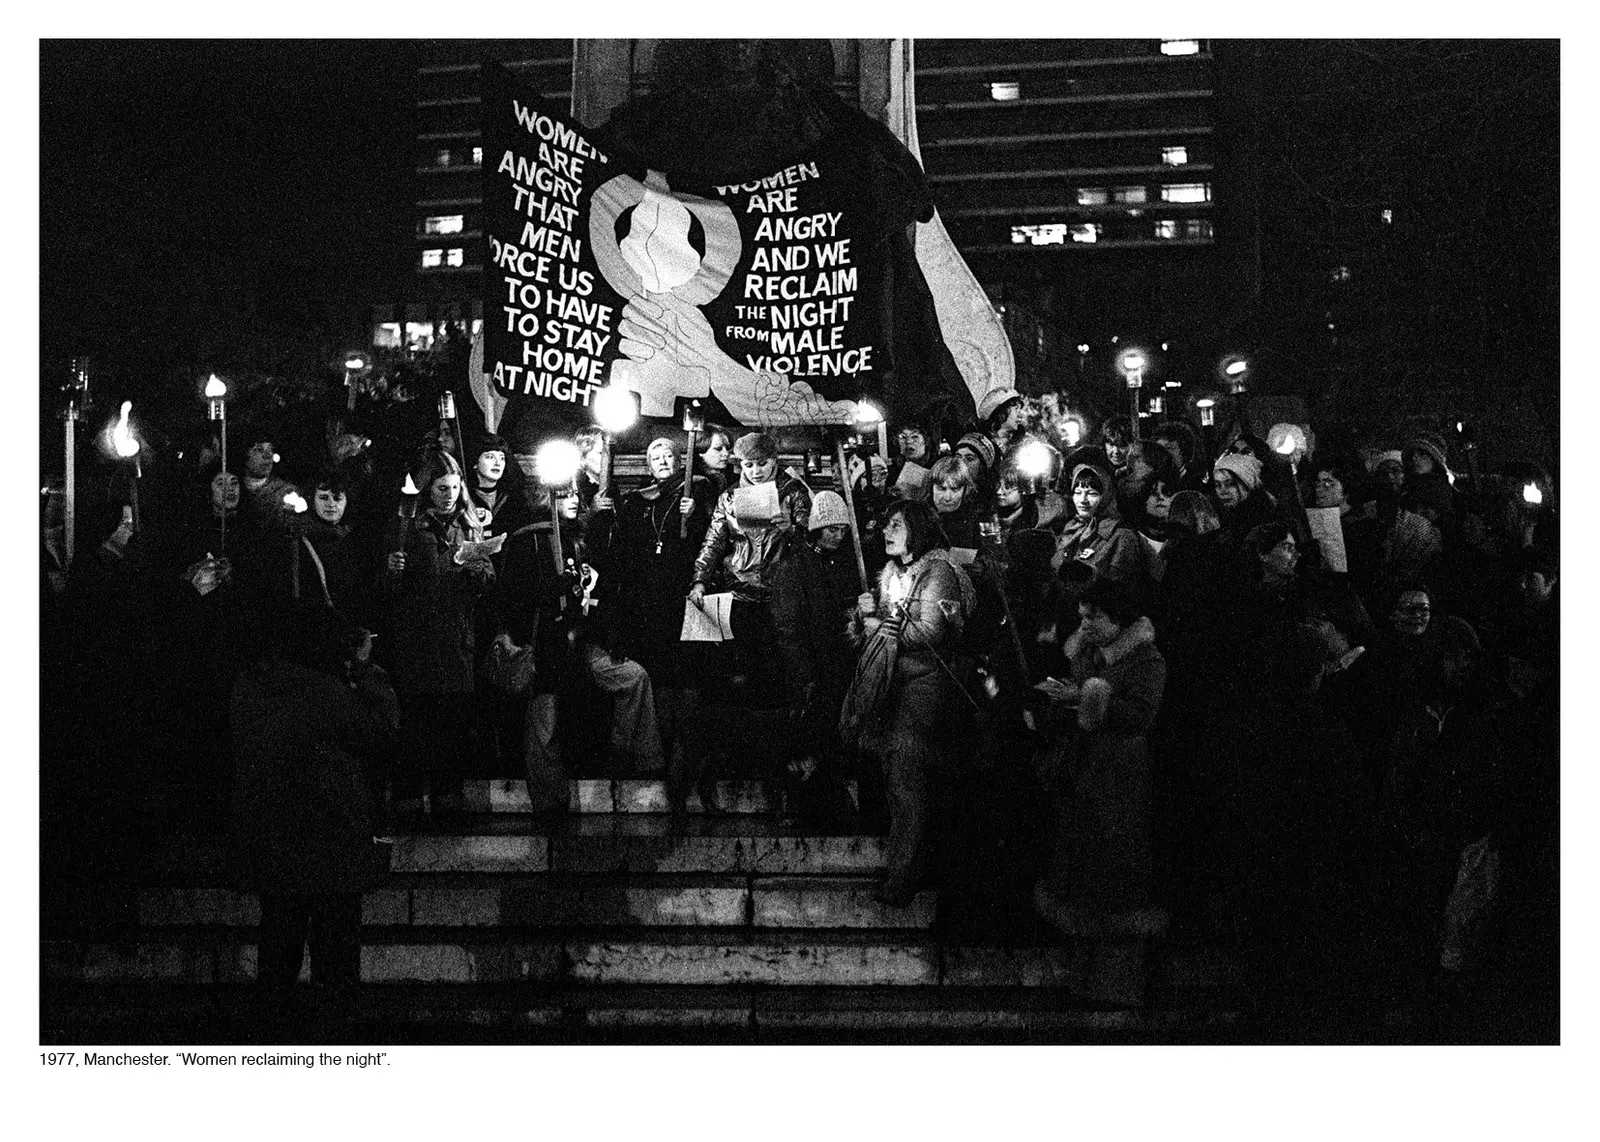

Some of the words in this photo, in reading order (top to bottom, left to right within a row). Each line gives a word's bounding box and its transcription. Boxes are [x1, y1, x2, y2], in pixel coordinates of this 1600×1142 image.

[498, 150, 582, 207] ANGRY
[538, 142, 585, 185] ARE
[512, 183, 580, 232] THAT
[746, 187, 799, 213] ARE
[519, 221, 582, 263] MEN
[754, 212, 843, 242] ANGRY
[489, 235, 552, 284] ORCE
[558, 263, 595, 296] US
[750, 246, 810, 273] AND
[814, 238, 851, 269] WE
[744, 267, 858, 301] RECLAIM
[504, 276, 542, 309] TO
[546, 289, 614, 332] HAVE
[735, 305, 767, 320] THE
[770, 296, 854, 330] NIGHT
[503, 306, 540, 337] TO
[543, 319, 611, 357] STAY
[726, 325, 770, 342] FROM
[770, 325, 845, 355] MALE
[493, 361, 523, 391] AT
[523, 340, 605, 385] HOME
[746, 346, 873, 377] VIOLENCE
